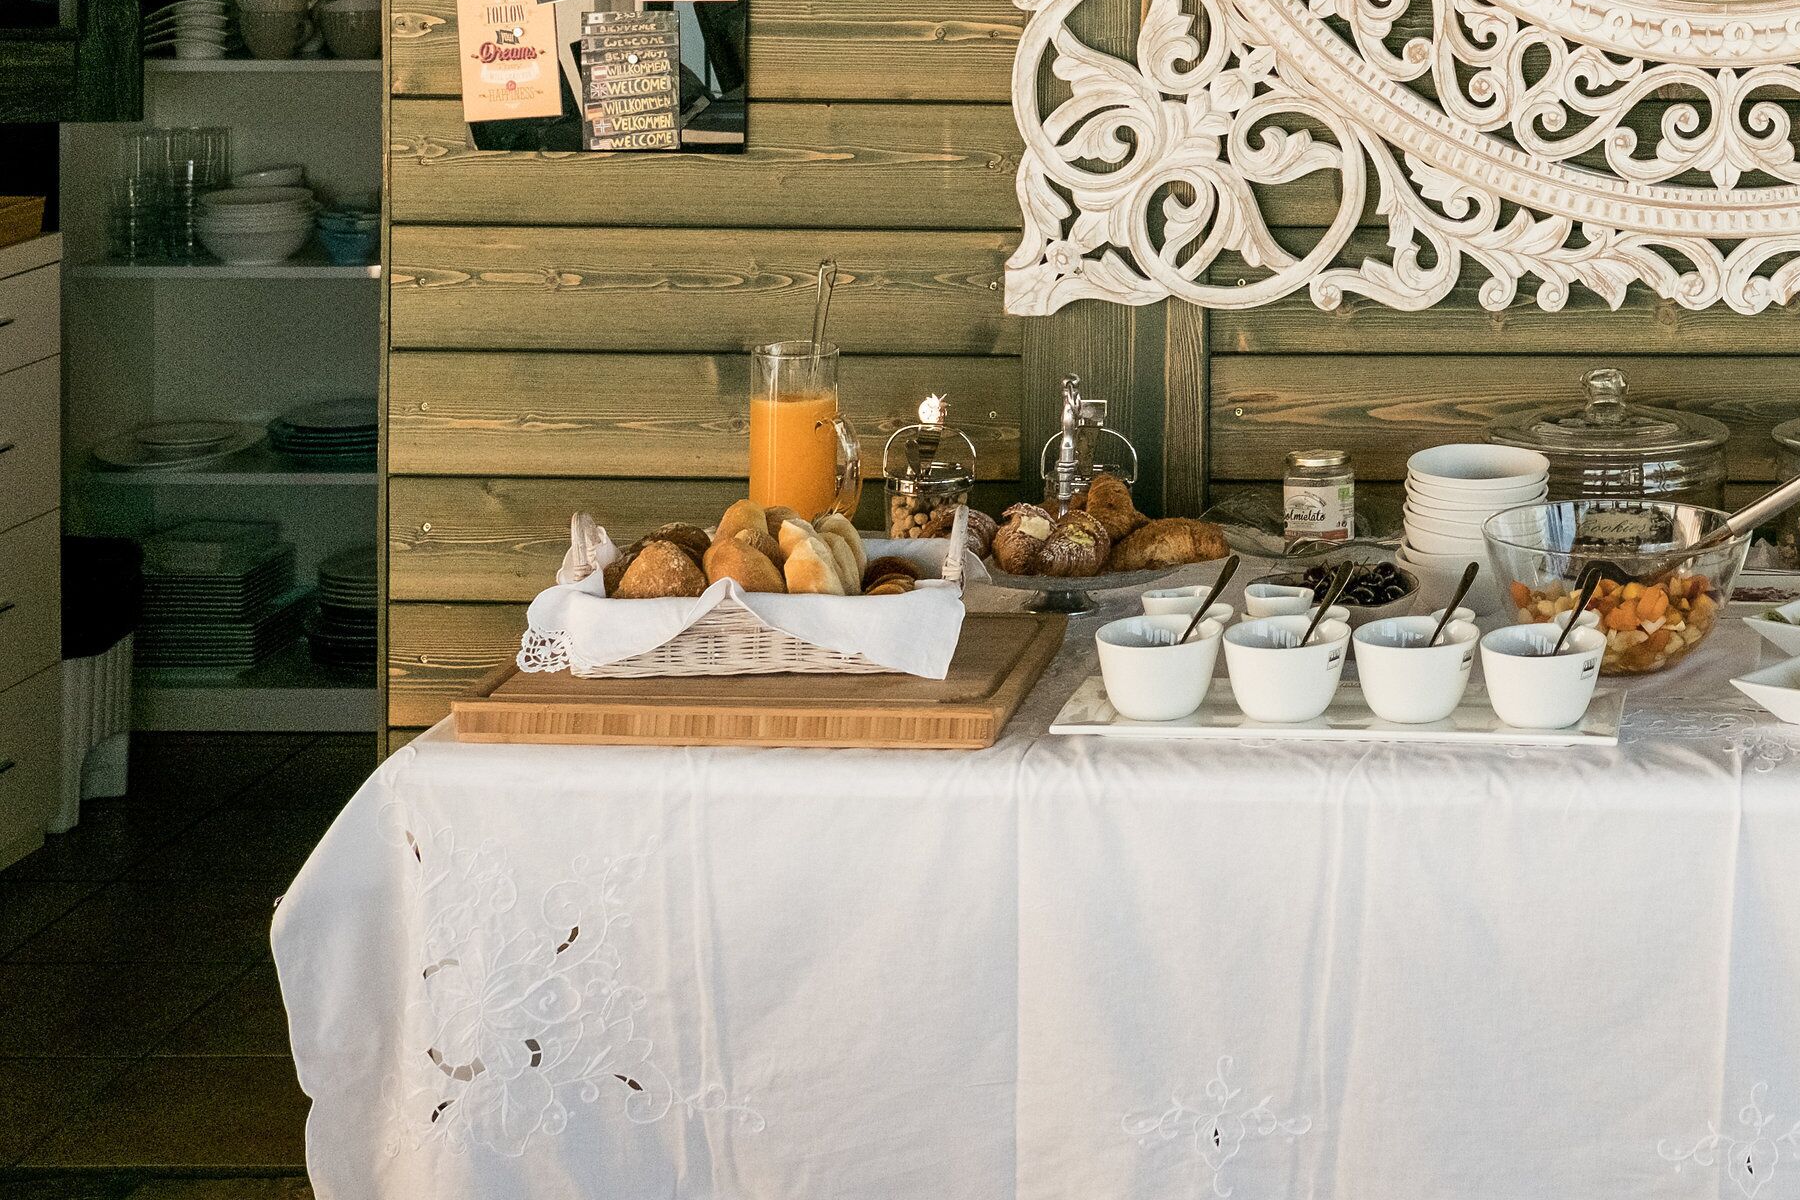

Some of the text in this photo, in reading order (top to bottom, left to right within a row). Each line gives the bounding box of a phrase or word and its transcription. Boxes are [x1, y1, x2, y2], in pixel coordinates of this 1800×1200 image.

[486, 4, 525, 24] FOLLOW
[480, 42, 538, 64] Dreams
[607, 60, 670, 76] WILLKOMMEN
[607, 78, 668, 95] WELCOME
[604, 96, 671, 115] WILLKOMMEN
[612, 115, 672, 131] VELKOMMEN
[611, 131, 673, 148] WELCOME
